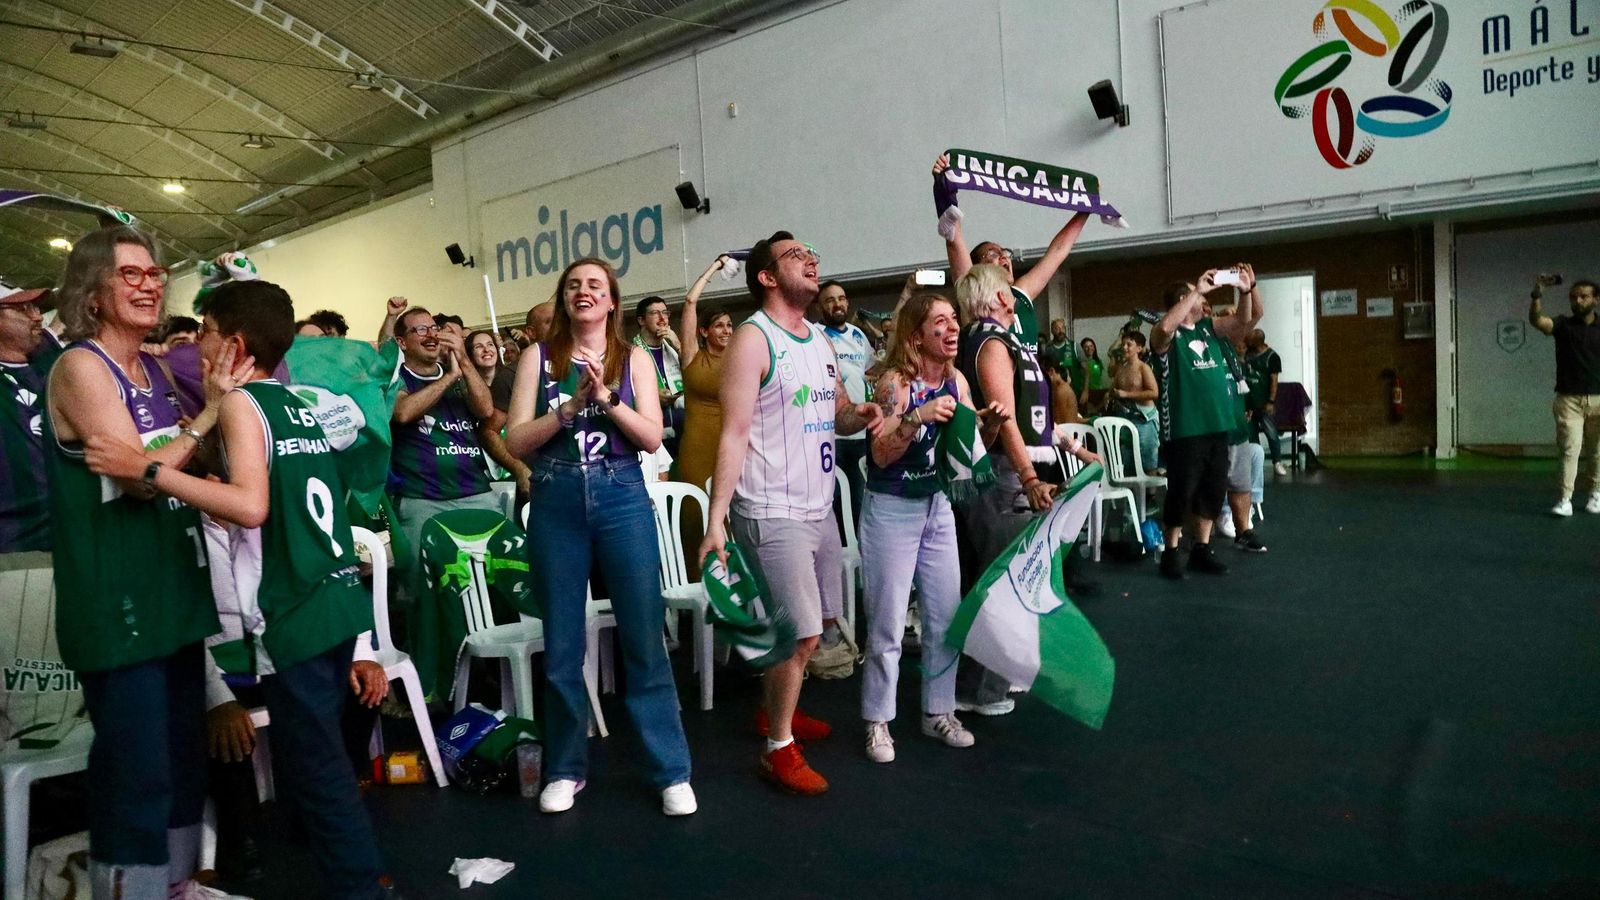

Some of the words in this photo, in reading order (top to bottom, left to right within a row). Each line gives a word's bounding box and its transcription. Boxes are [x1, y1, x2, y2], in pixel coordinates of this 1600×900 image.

[1483, 56, 1574, 98] Deporte
[1587, 54, 1600, 84] y
[944, 153, 1092, 207] UNICAJA
[574, 430, 607, 463] 12
[820, 441, 833, 473] 6
